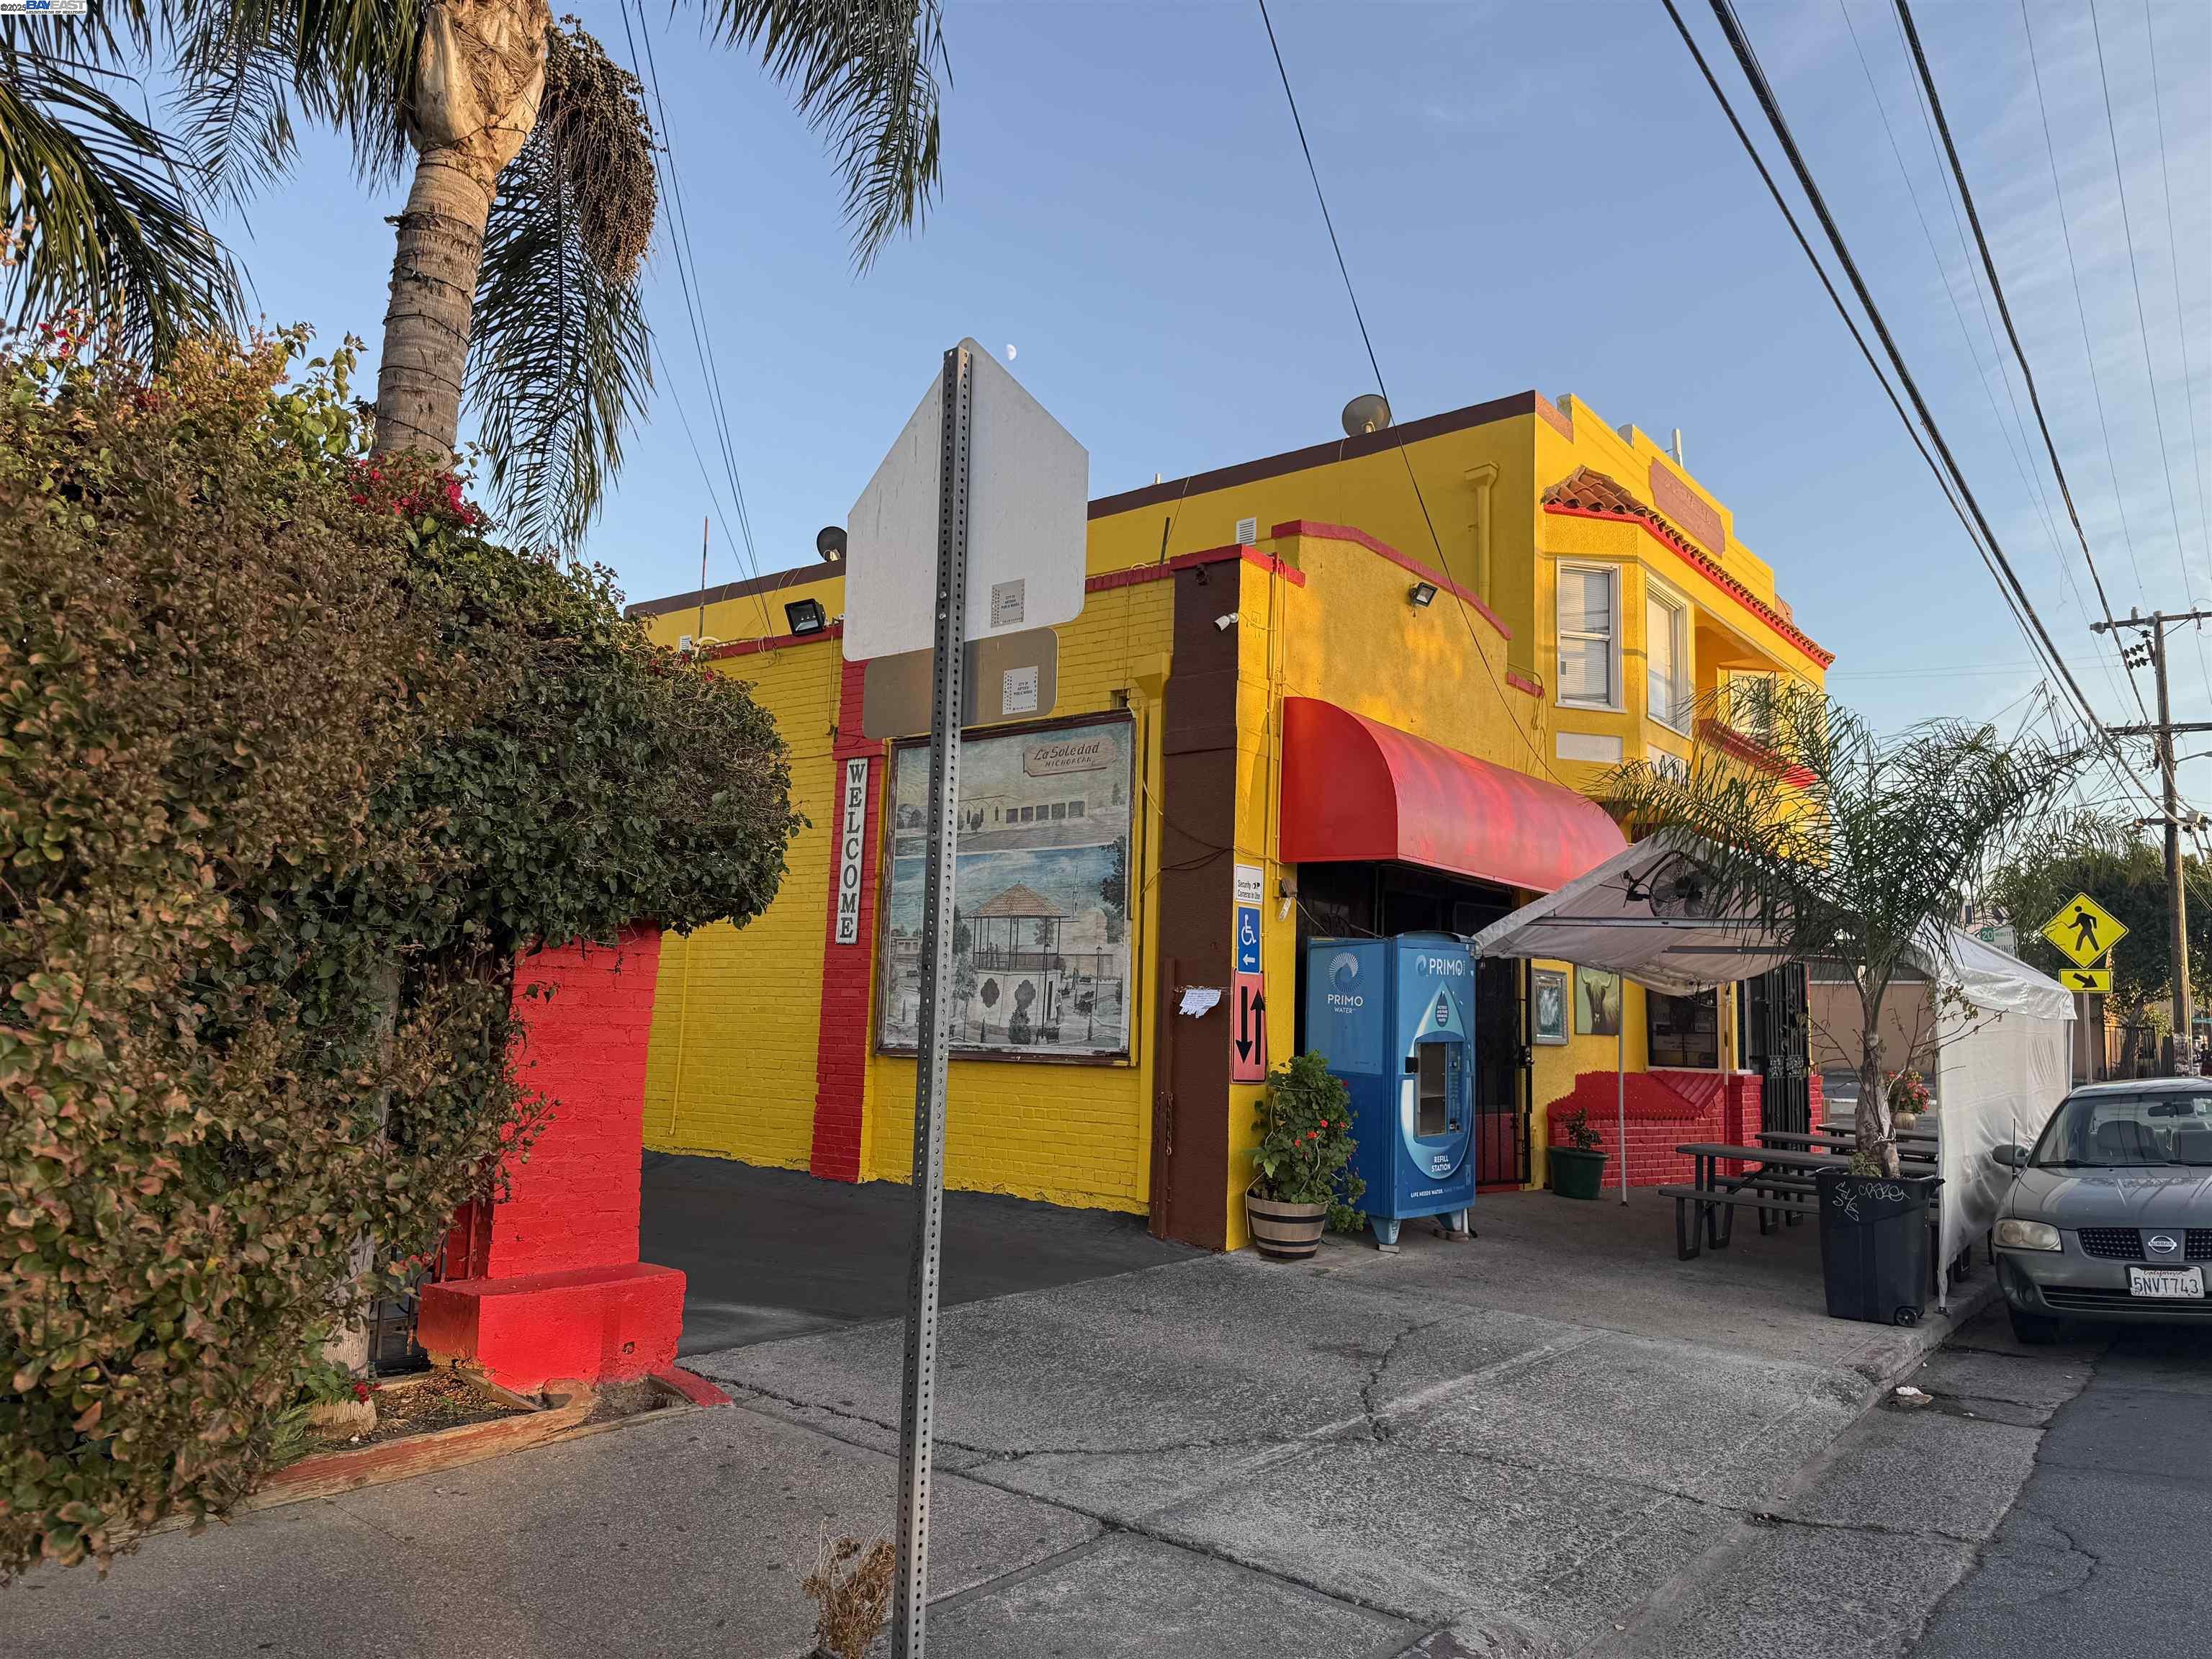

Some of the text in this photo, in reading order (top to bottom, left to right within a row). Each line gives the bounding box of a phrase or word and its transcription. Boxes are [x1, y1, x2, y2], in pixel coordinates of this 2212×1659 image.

[839, 763, 866, 938] WELCOME
[1982, 930, 1993, 940] 20
[1429, 958, 1463, 976] PRIMO
[1327, 994, 1363, 1007] PRIMO
[1431, 1163, 1451, 1172] STATION
[2134, 1277, 2198, 1294] 5NVT743
